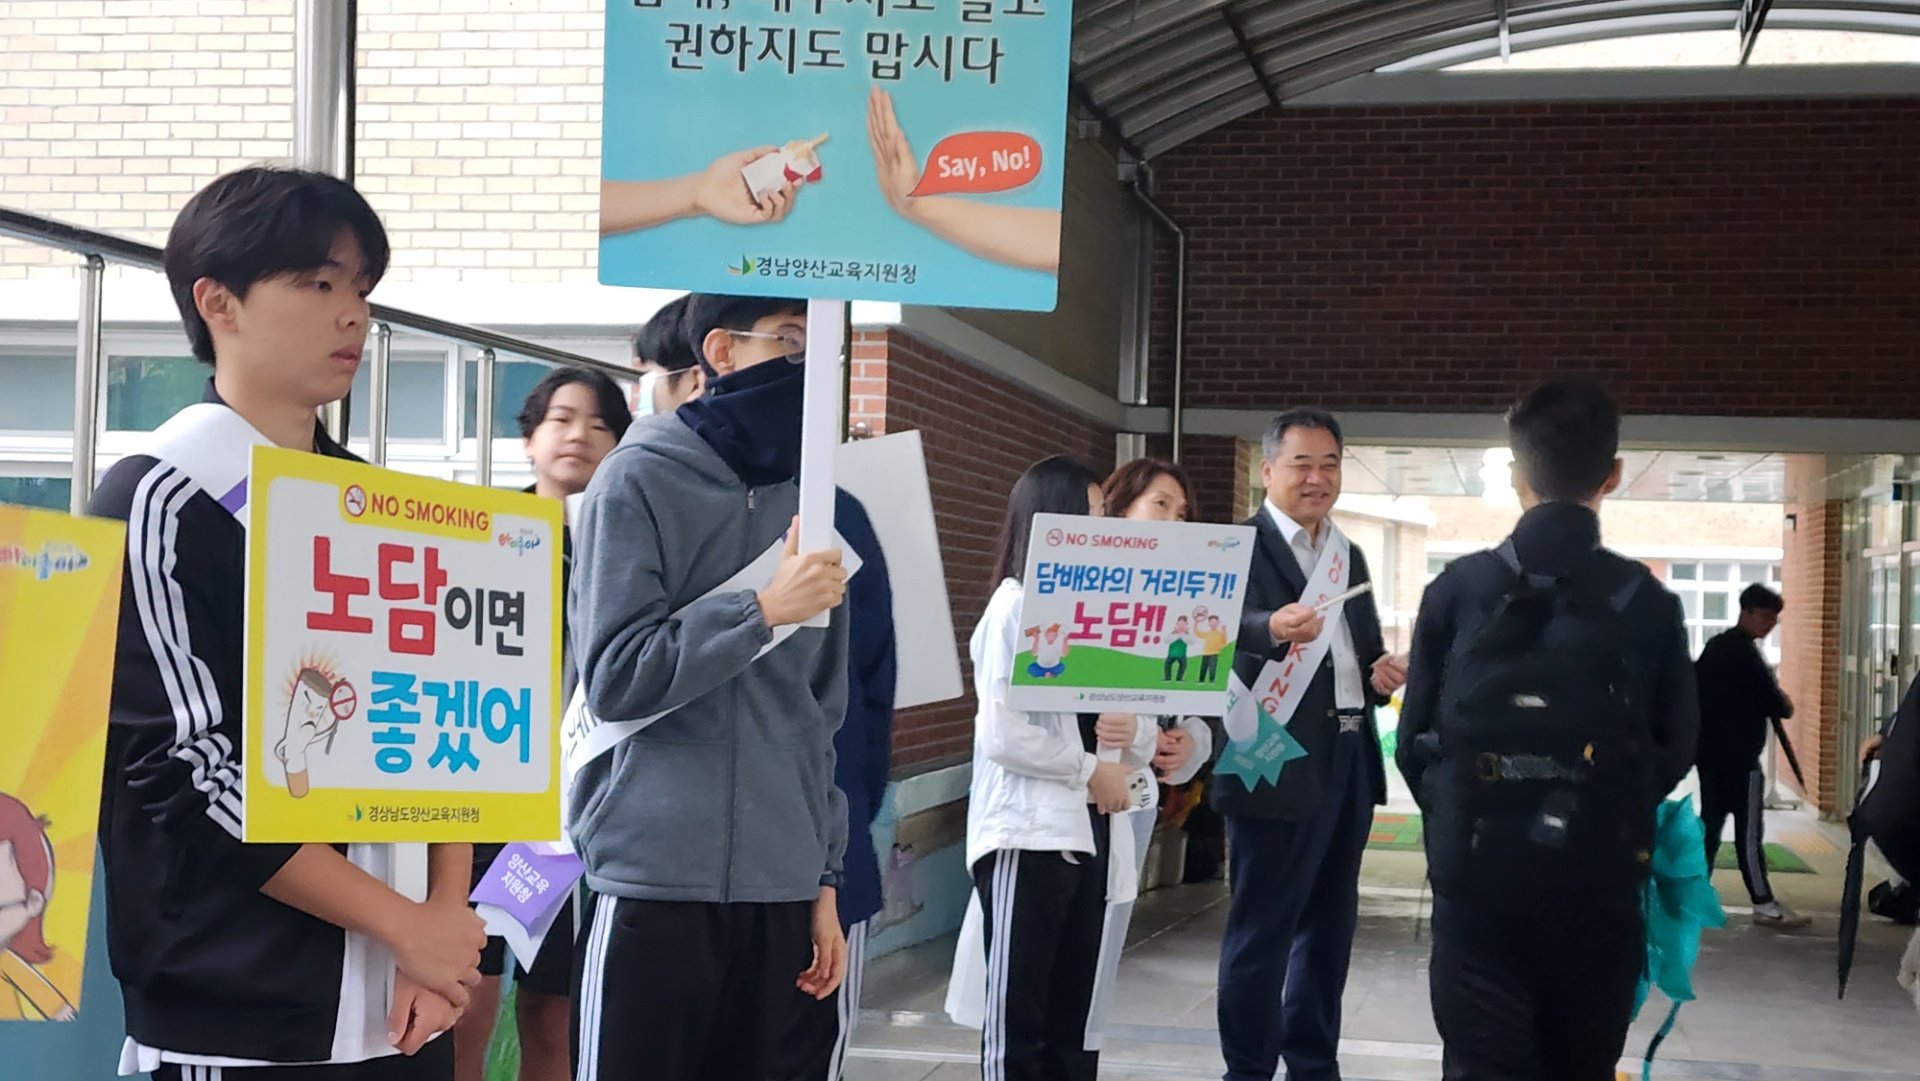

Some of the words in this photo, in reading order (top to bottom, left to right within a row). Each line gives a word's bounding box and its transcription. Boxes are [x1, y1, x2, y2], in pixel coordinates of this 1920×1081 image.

[665, 23, 845, 75] 권하지도
[866, 32, 1005, 84] 맙시다
[938, 155, 986, 181] Say,
[992, 145, 1031, 172] No!
[756, 256, 917, 284] 경남양산교육지원청
[371, 493, 400, 517] NO
[404, 498, 489, 531] SMOKING
[1065, 533, 1088, 546] NO
[1091, 534, 1159, 550] SMOKING
[306, 535, 525, 656] 노담이면
[1036, 562, 1134, 594] 담배와의
[1140, 568, 1237, 599] 거리두기!
[1068, 601, 1168, 647] 노담!!
[367, 670, 531, 775] 좋겠어
[368, 805, 480, 824] 경상남도양산교육지원청
[501, 871, 534, 904] 지원청
[508, 853, 550, 895] 양산교육
